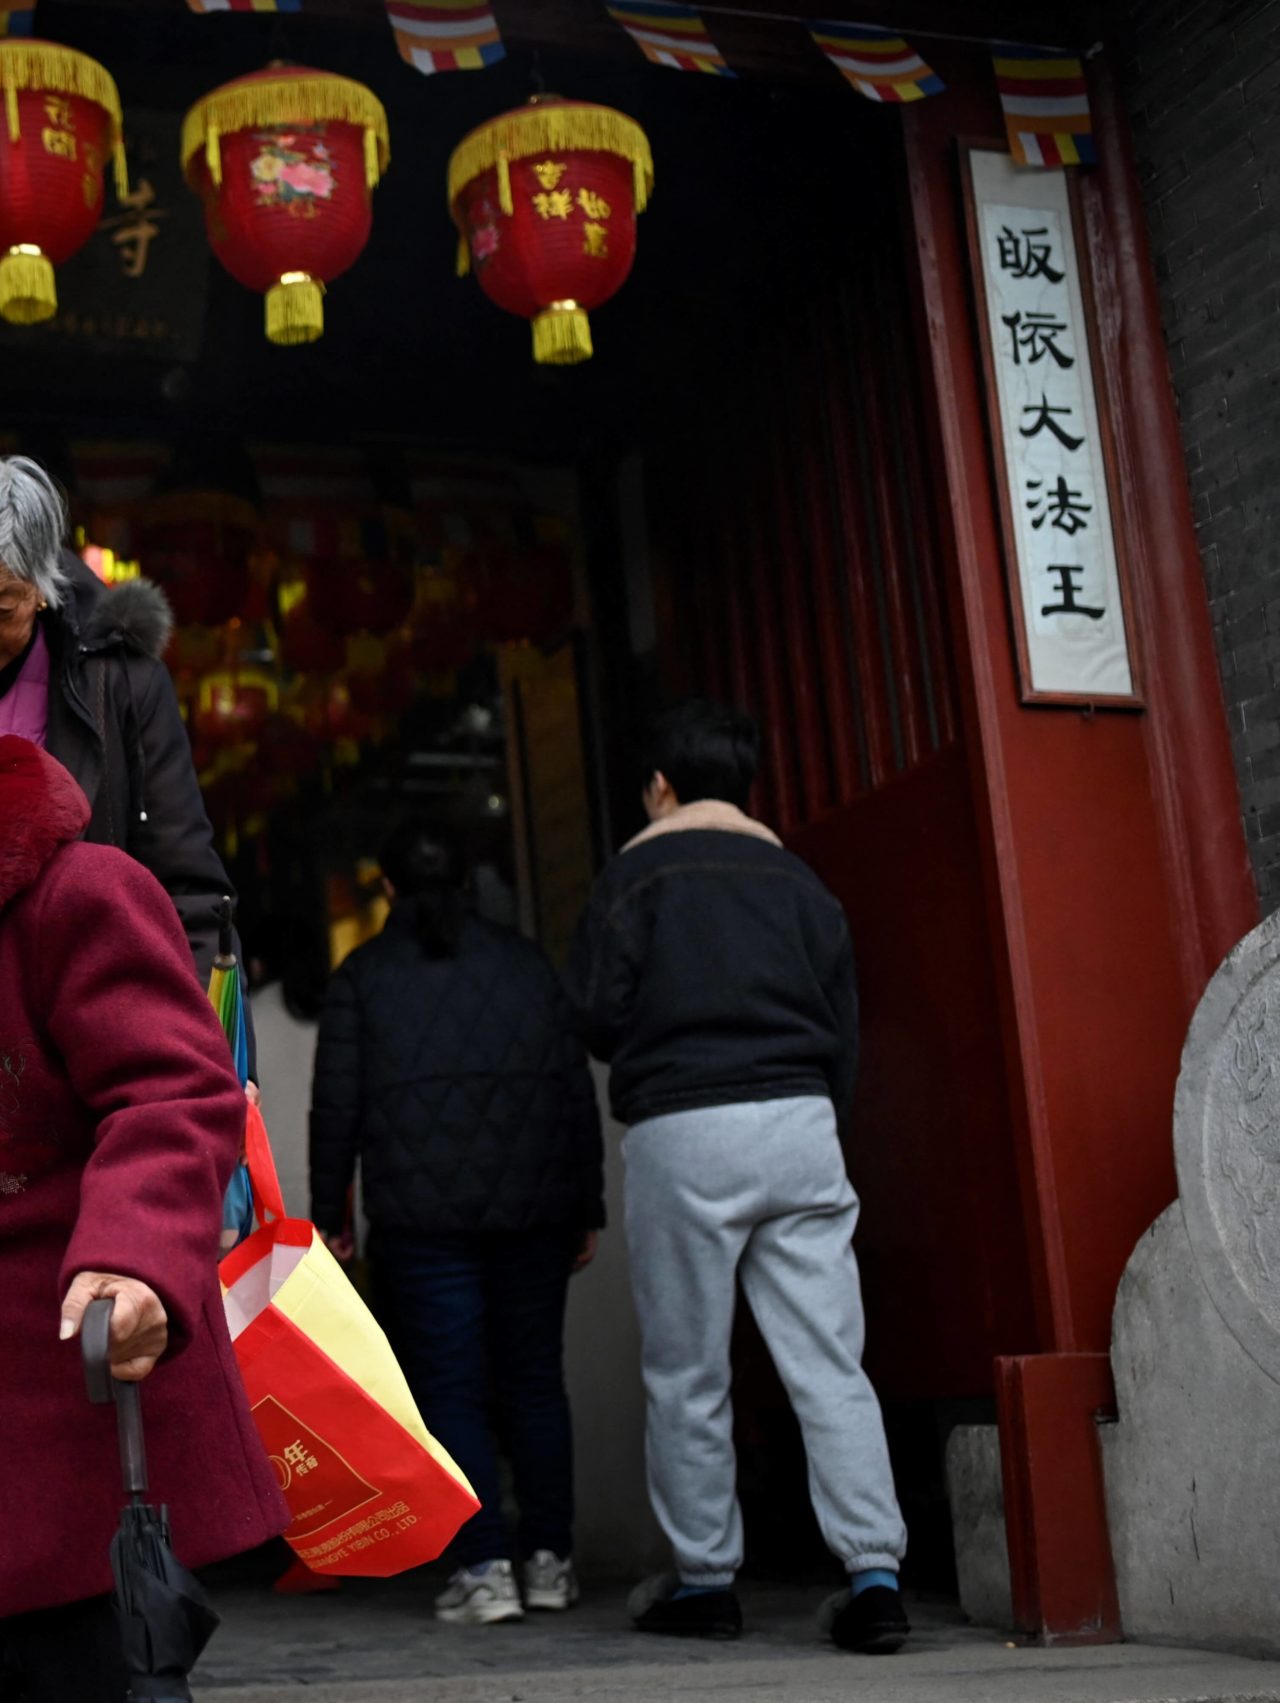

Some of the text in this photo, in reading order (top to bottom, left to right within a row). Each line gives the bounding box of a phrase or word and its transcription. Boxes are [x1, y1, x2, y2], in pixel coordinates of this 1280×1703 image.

[996, 226, 1106, 620] 皈依大法王
[283, 1439, 308, 1466] 年
